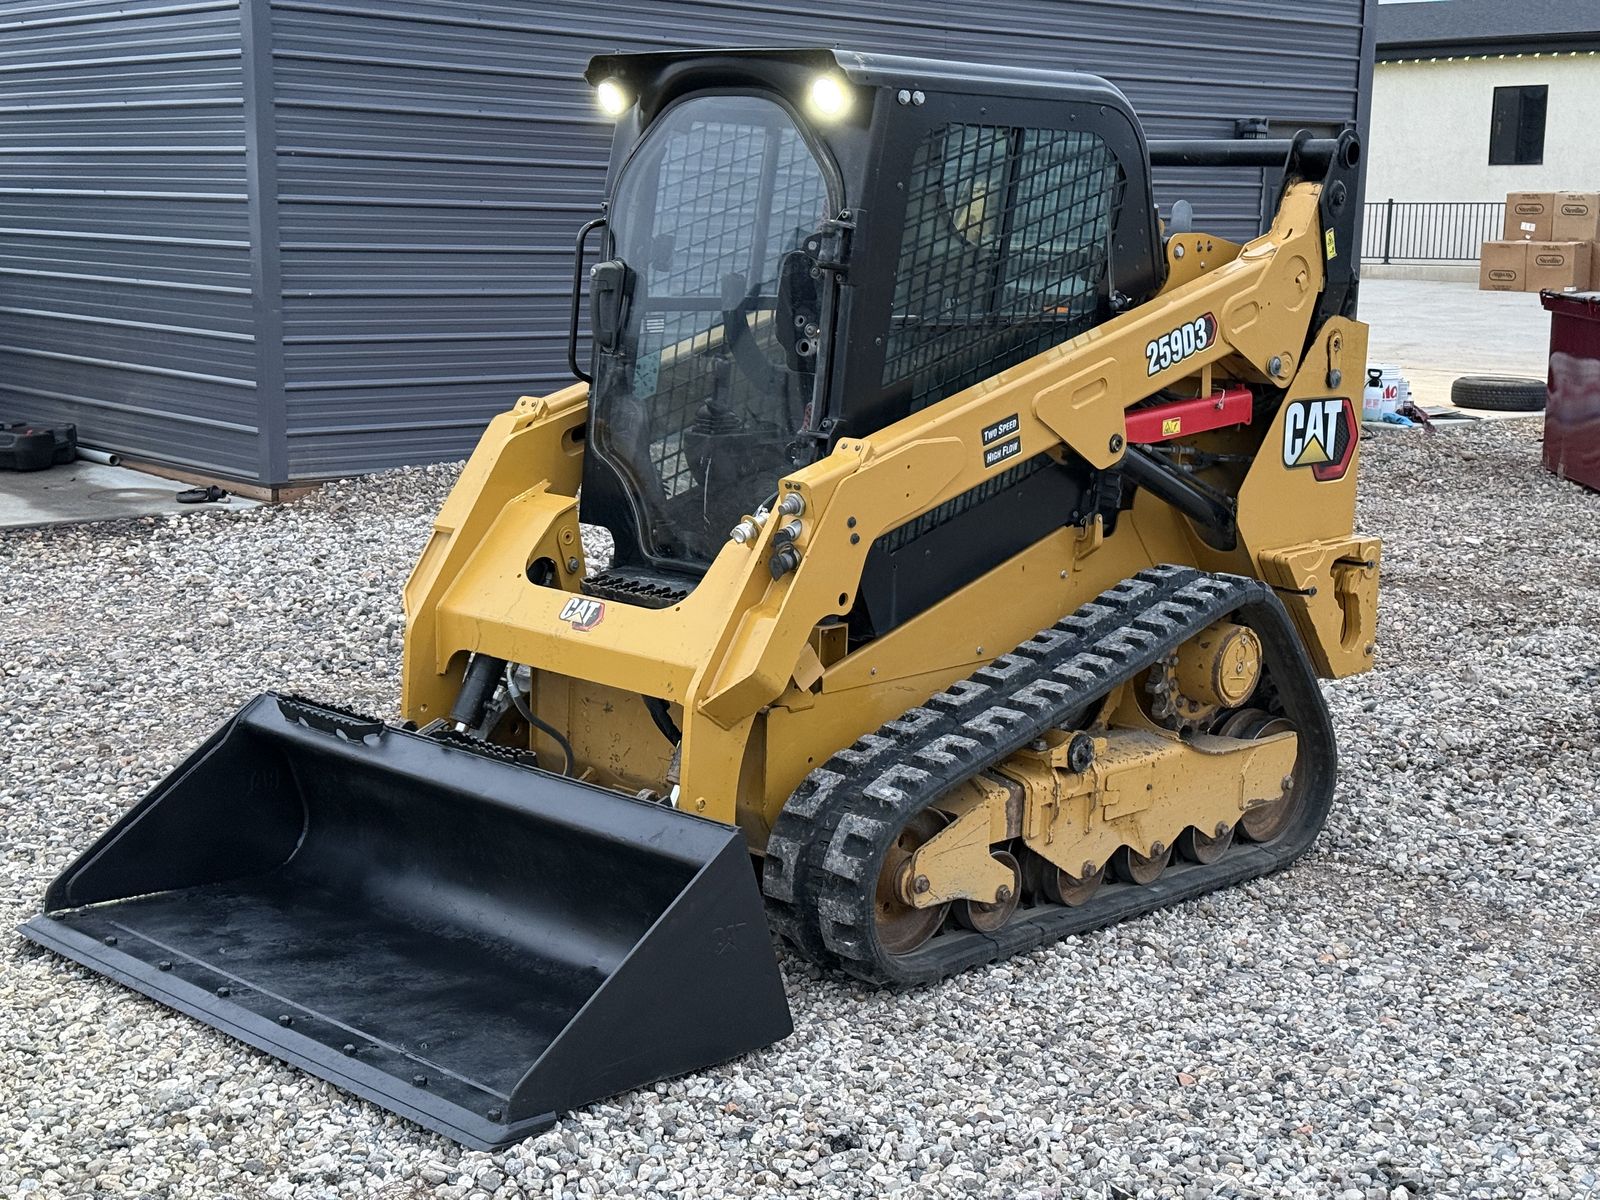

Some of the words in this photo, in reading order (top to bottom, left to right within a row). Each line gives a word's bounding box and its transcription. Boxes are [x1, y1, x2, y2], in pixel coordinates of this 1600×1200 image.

[1146, 317, 1207, 375] 259D3
[1284, 400, 1342, 465] CAT
[560, 597, 601, 625] CAT
